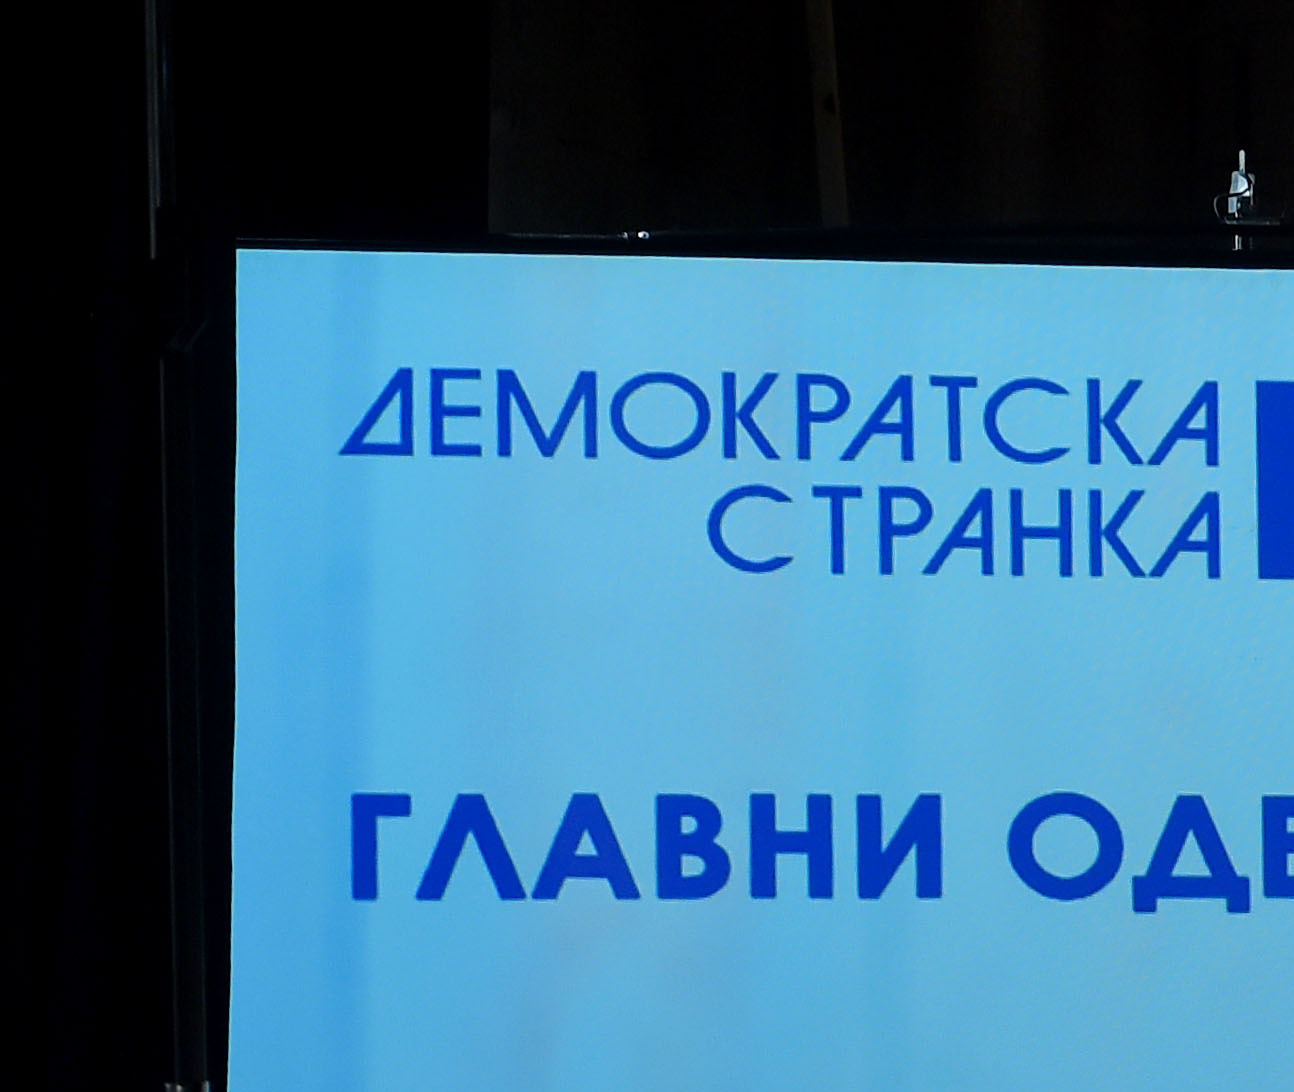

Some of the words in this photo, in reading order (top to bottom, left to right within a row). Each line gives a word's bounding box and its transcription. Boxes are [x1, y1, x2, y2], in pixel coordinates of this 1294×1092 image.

[338, 366, 1221, 467] ДЕМОКРАТСКА
[707, 484, 1222, 579] СТРАНКА
[350, 792, 943, 901] ГЛАВНИ
